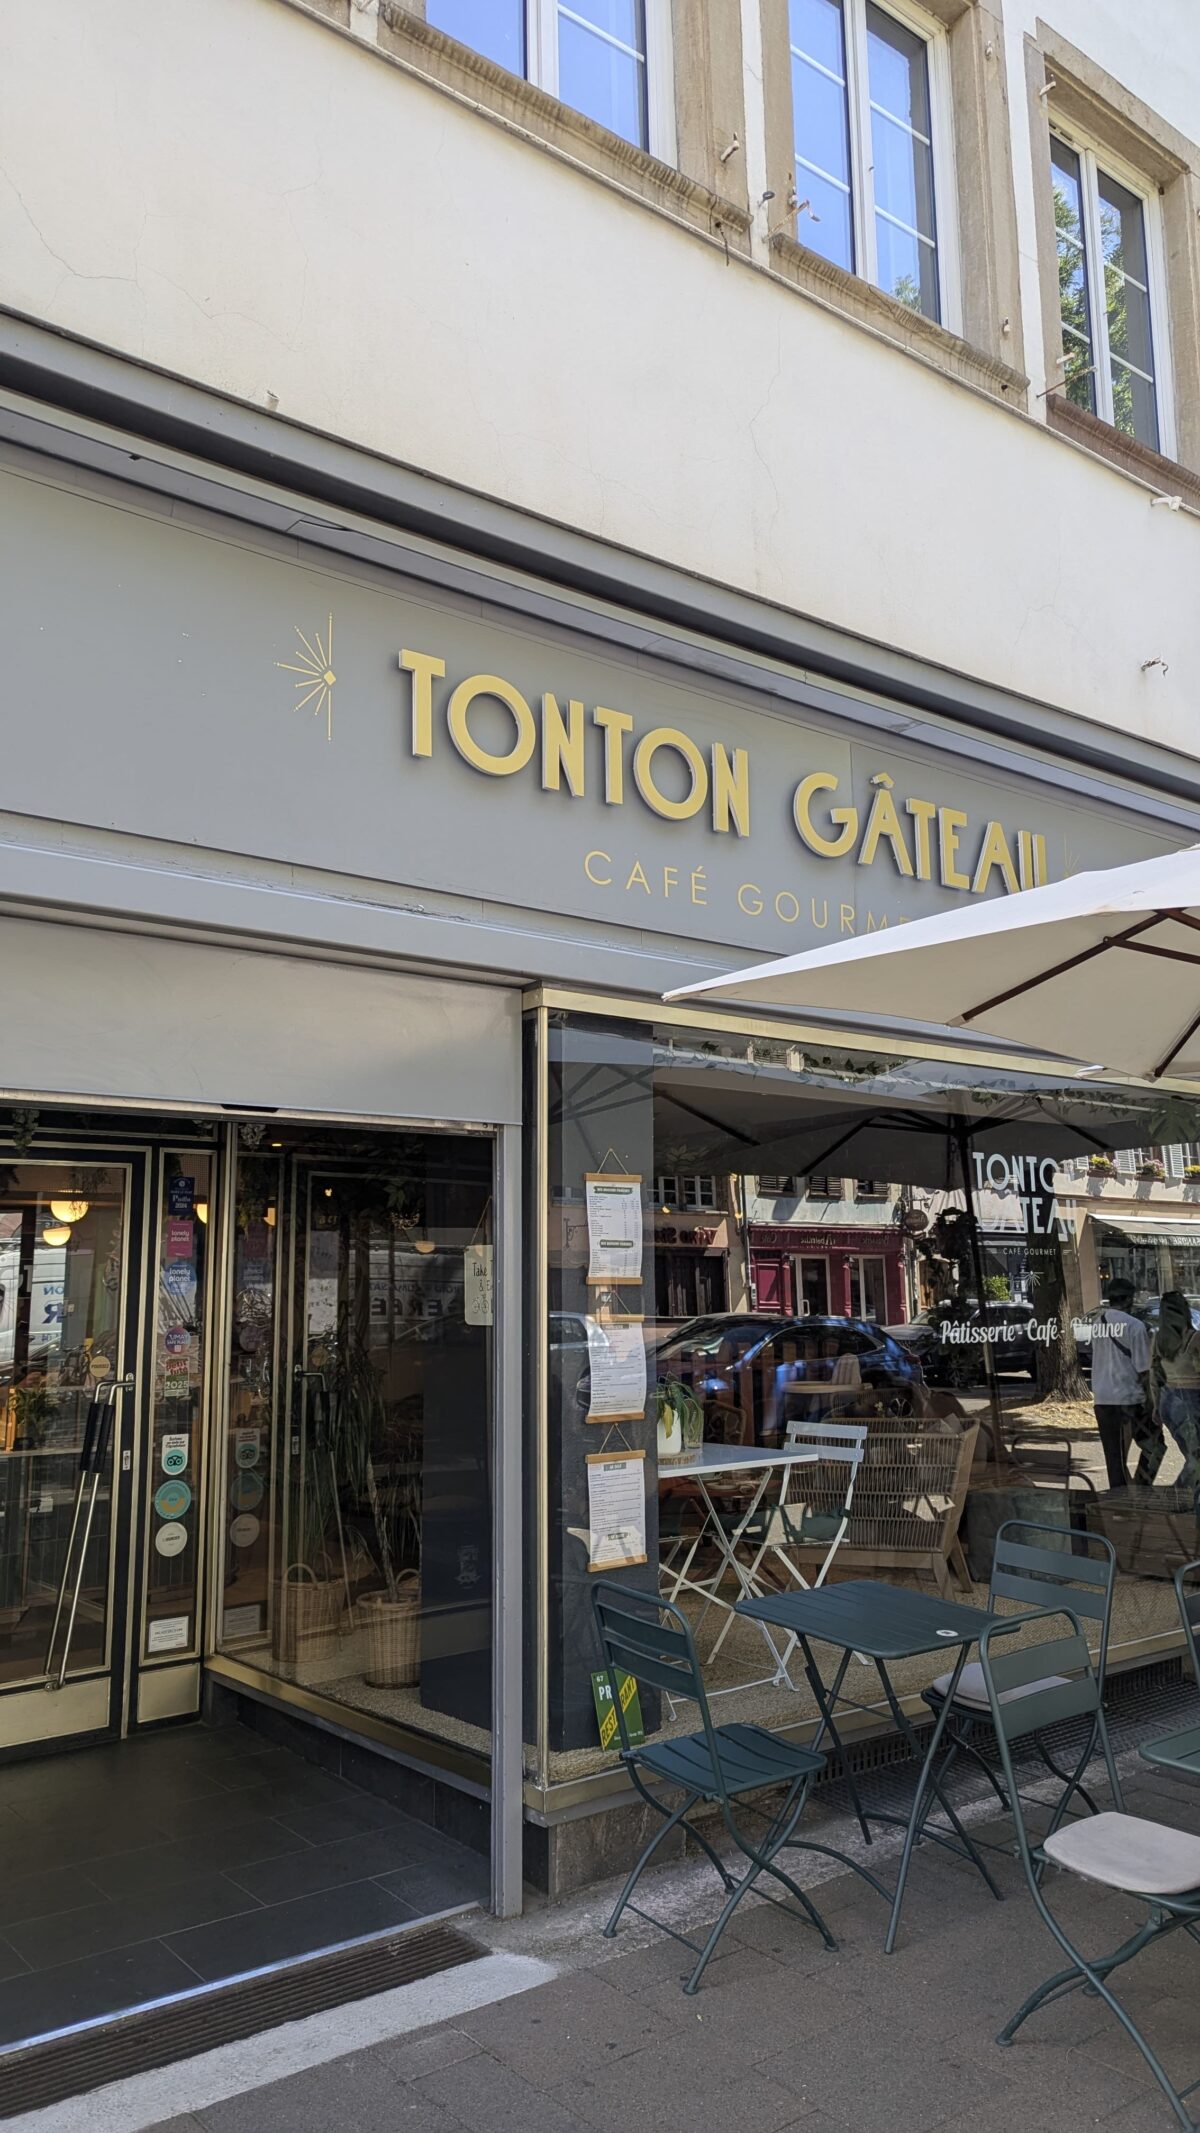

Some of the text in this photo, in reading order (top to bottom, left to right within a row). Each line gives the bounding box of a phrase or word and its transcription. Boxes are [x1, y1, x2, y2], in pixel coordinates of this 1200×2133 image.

[397, 648, 1048, 895] TONTON GÂTEAU
[583, 849, 912, 935] CAFÉ GOURM
[972, 1151, 1076, 1195] TONTO
[171, 1229, 190, 1237] lonely
[170, 1235, 190, 1243] planet
[1002, 1247, 1057, 1256] CAFÉ GOURMET
[169, 1267, 191, 1277] lonely
[472, 1262, 488, 1277] Take
[168, 1274, 191, 1283] planet
[940, 1320, 1016, 1345] Pâtisserie
[1026, 1317, 1060, 1347] Café
[165, 1381, 189, 1389] 2025
